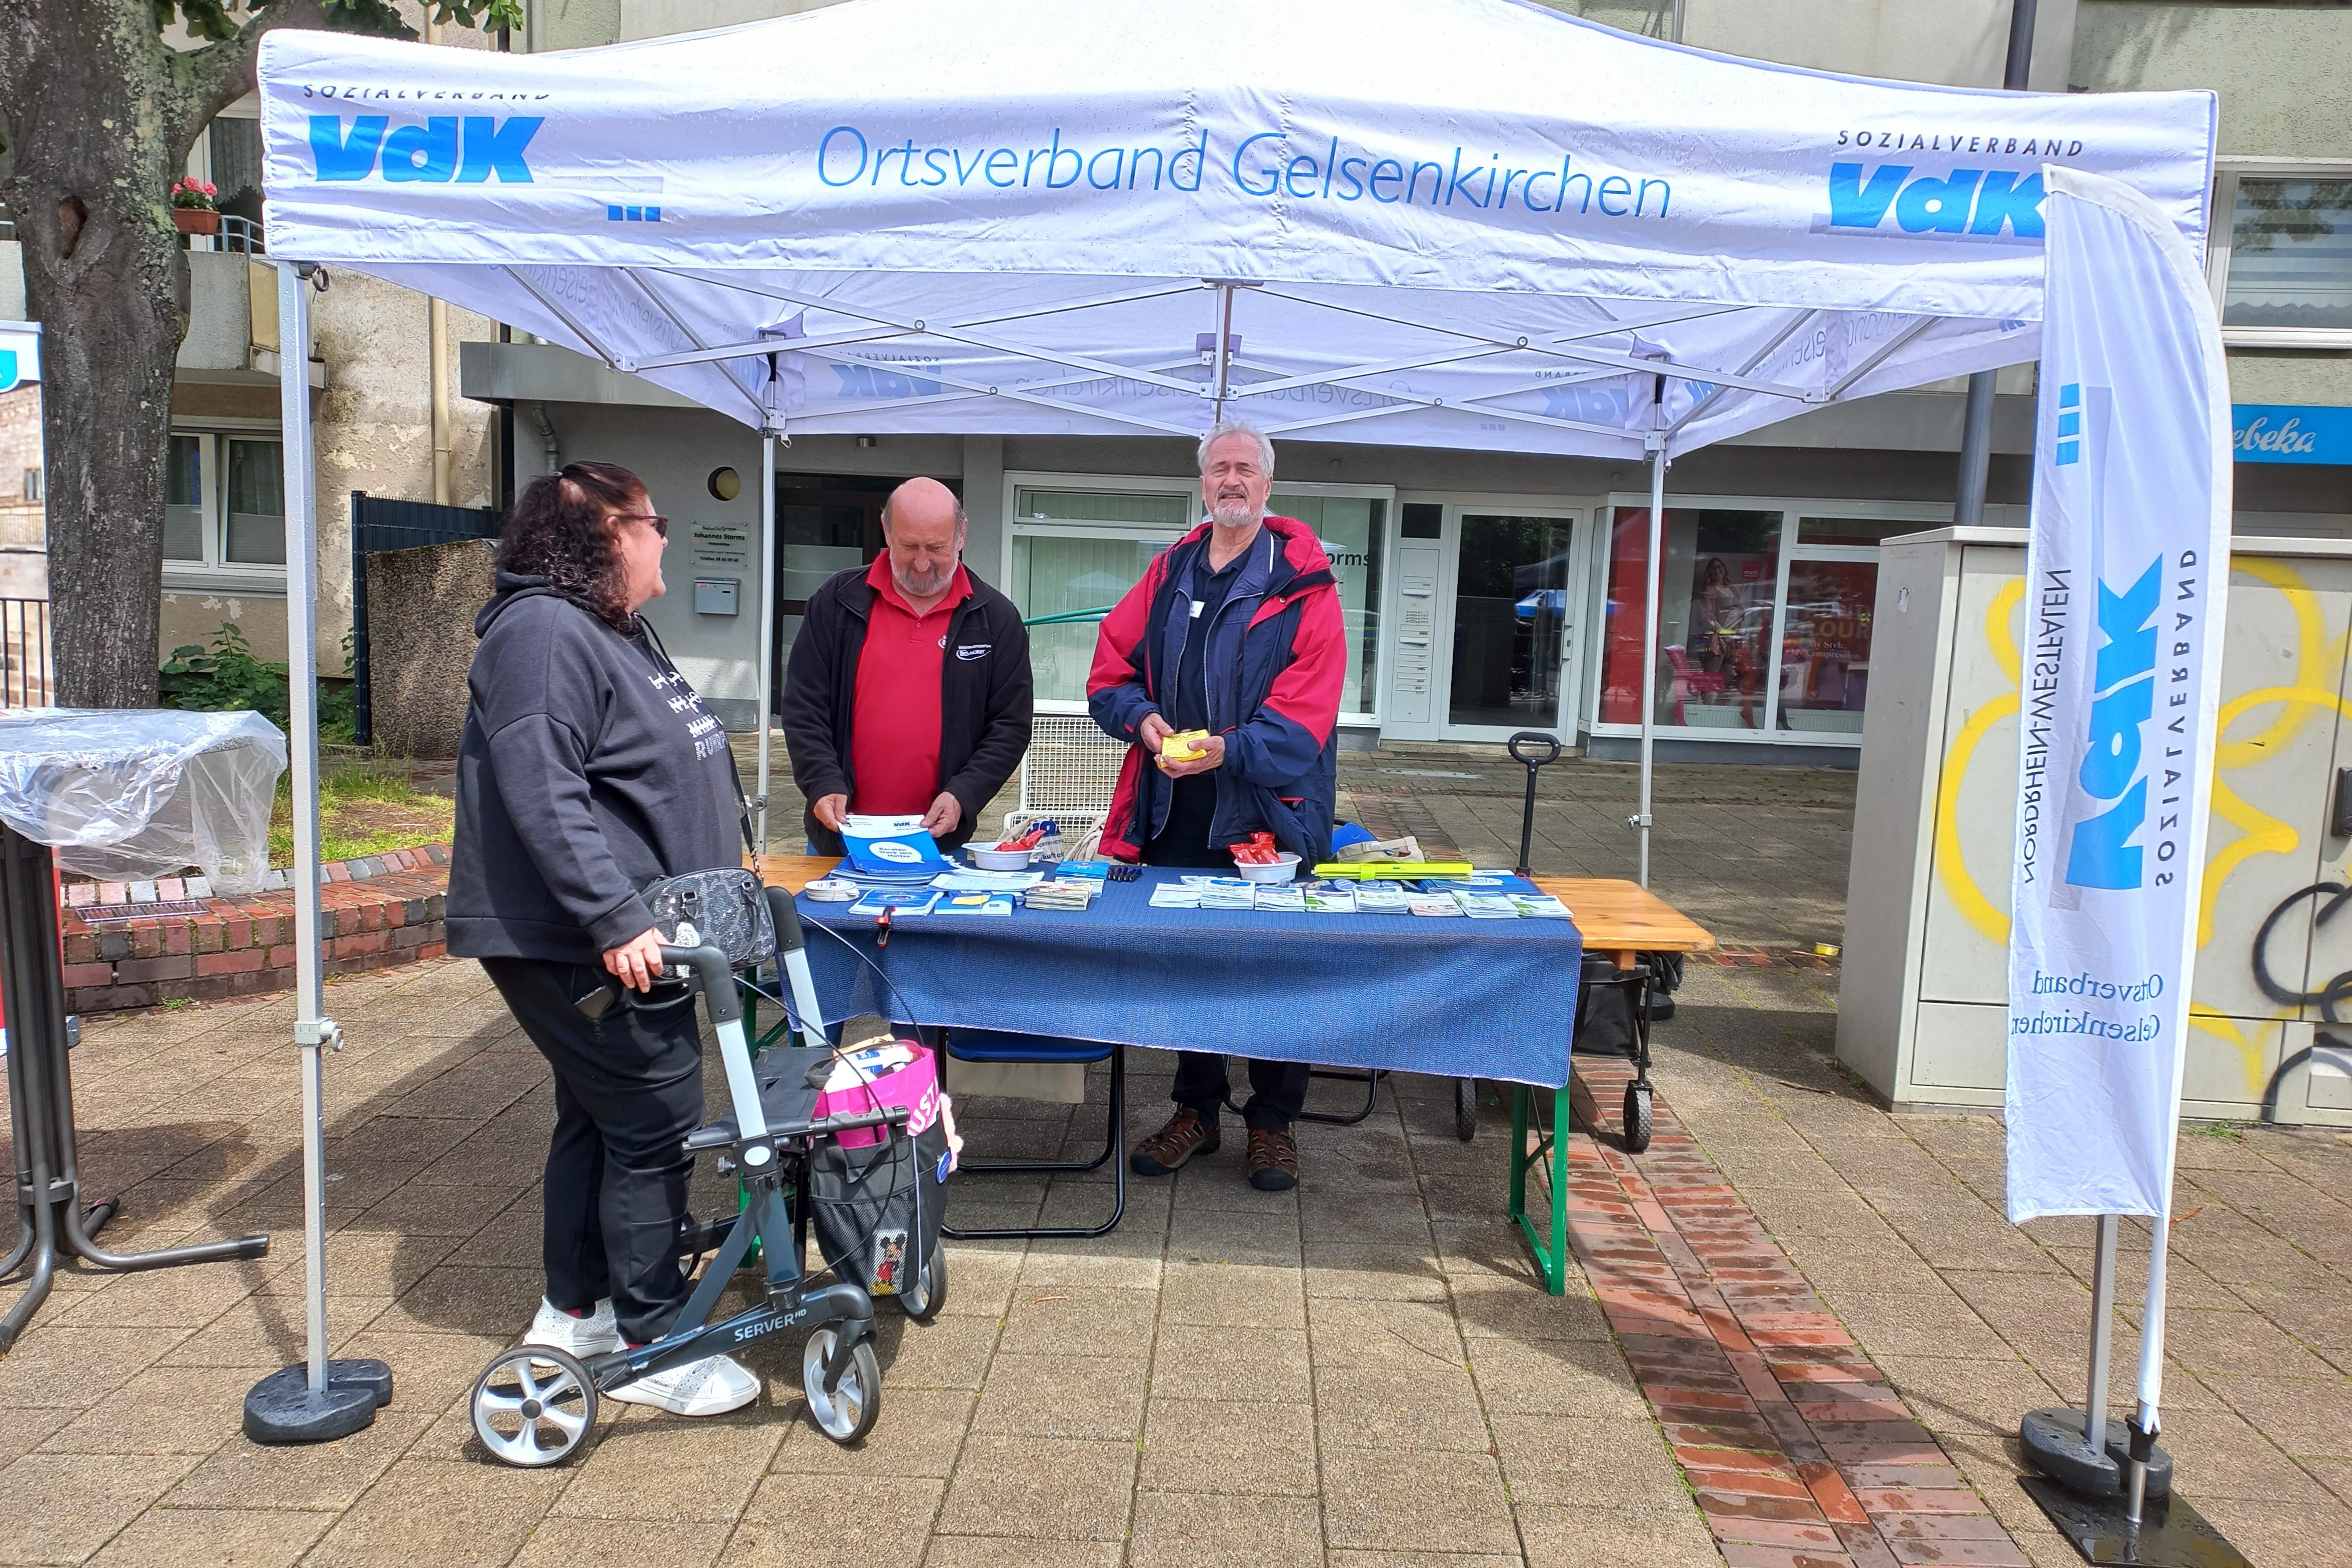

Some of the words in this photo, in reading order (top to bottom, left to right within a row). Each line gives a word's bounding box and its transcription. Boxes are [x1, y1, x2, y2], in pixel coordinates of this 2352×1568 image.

[309, 115, 546, 184] VdK
[1837, 130, 2084, 157] SOZIALVERBAND
[817, 126, 1209, 192] Ortsverband
[1233, 132, 1671, 218] Gelsenkirchen
[1829, 163, 2046, 239] VdK
[2233, 417, 2316, 454] ebeka
[1326, 553, 1369, 566] orms
